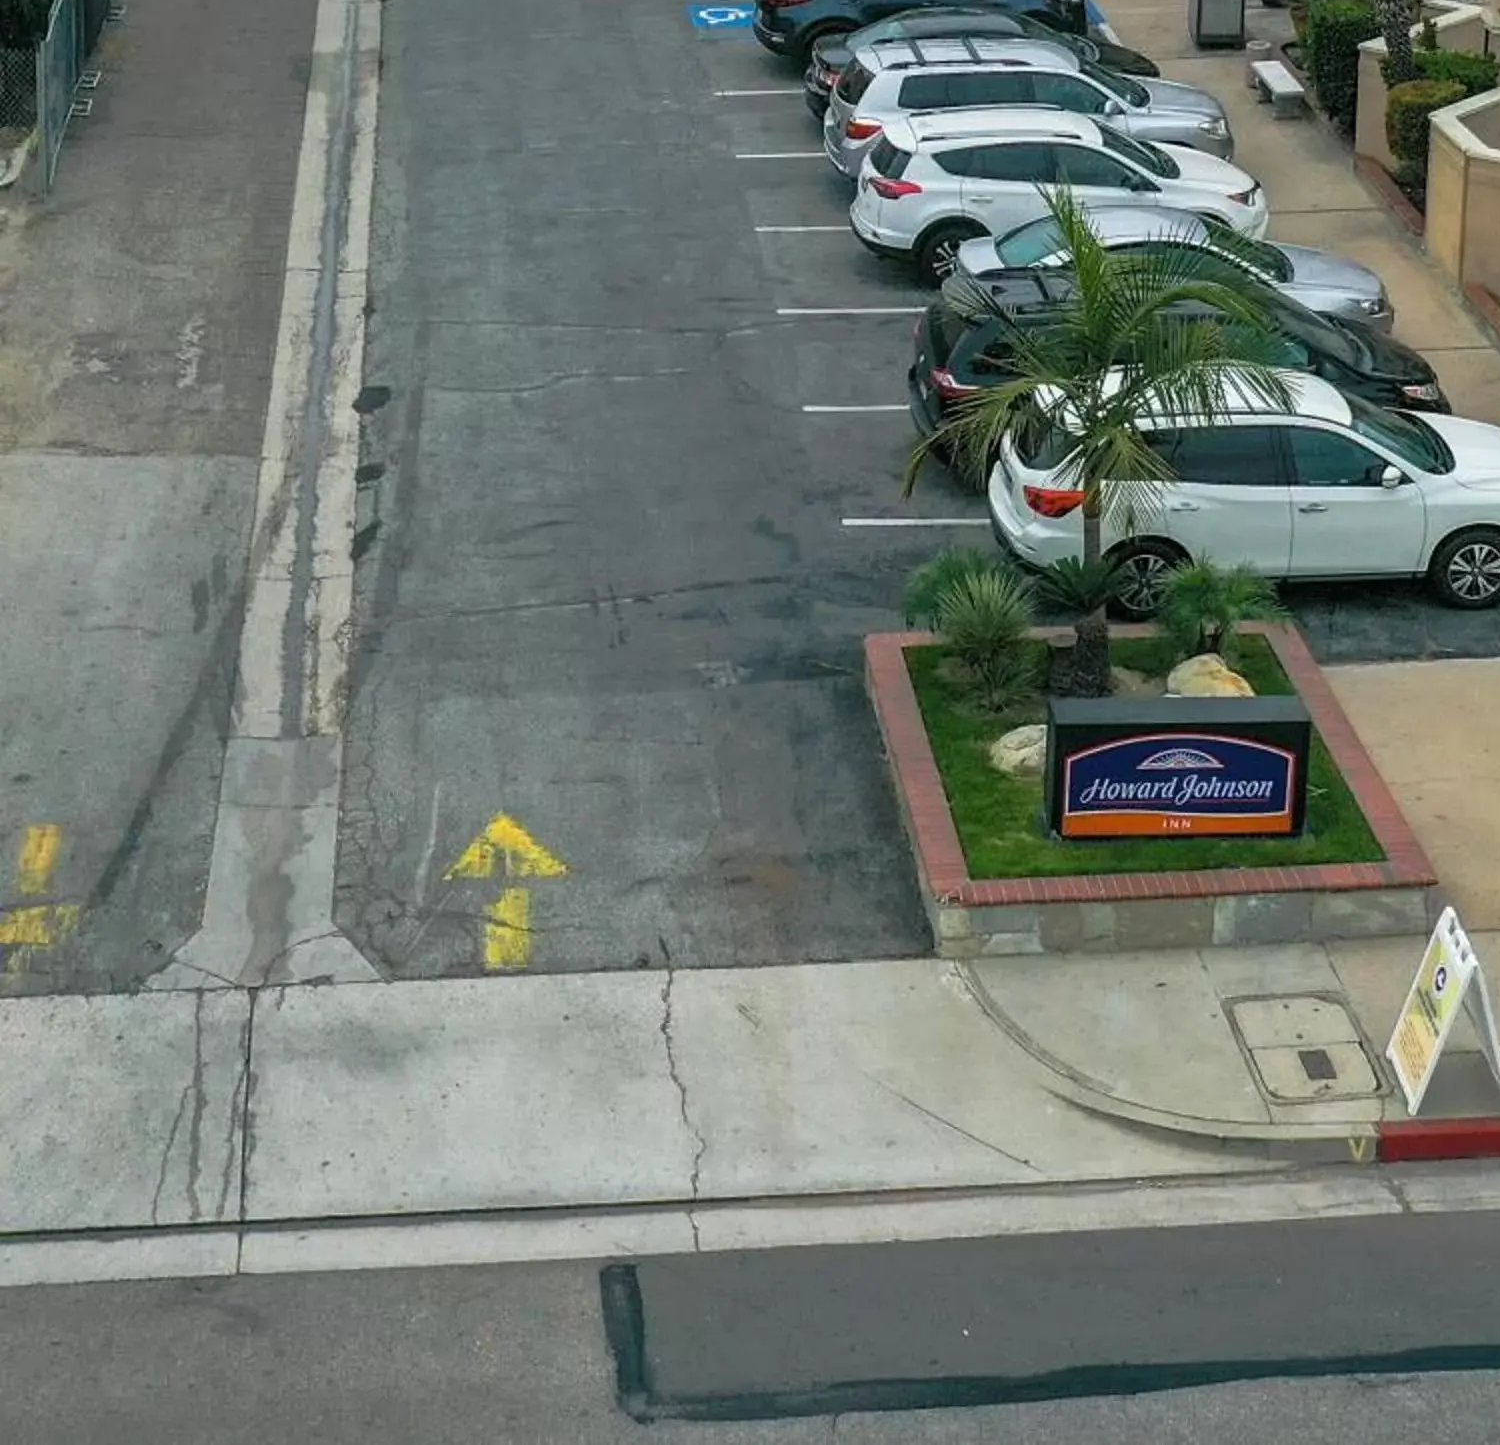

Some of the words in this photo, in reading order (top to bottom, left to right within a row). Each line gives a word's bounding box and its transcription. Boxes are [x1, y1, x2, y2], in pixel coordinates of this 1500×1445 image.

[1080, 776, 1175, 804] Howard
[1175, 773, 1273, 806] Johnson
[1162, 818, 1192, 830] INN
